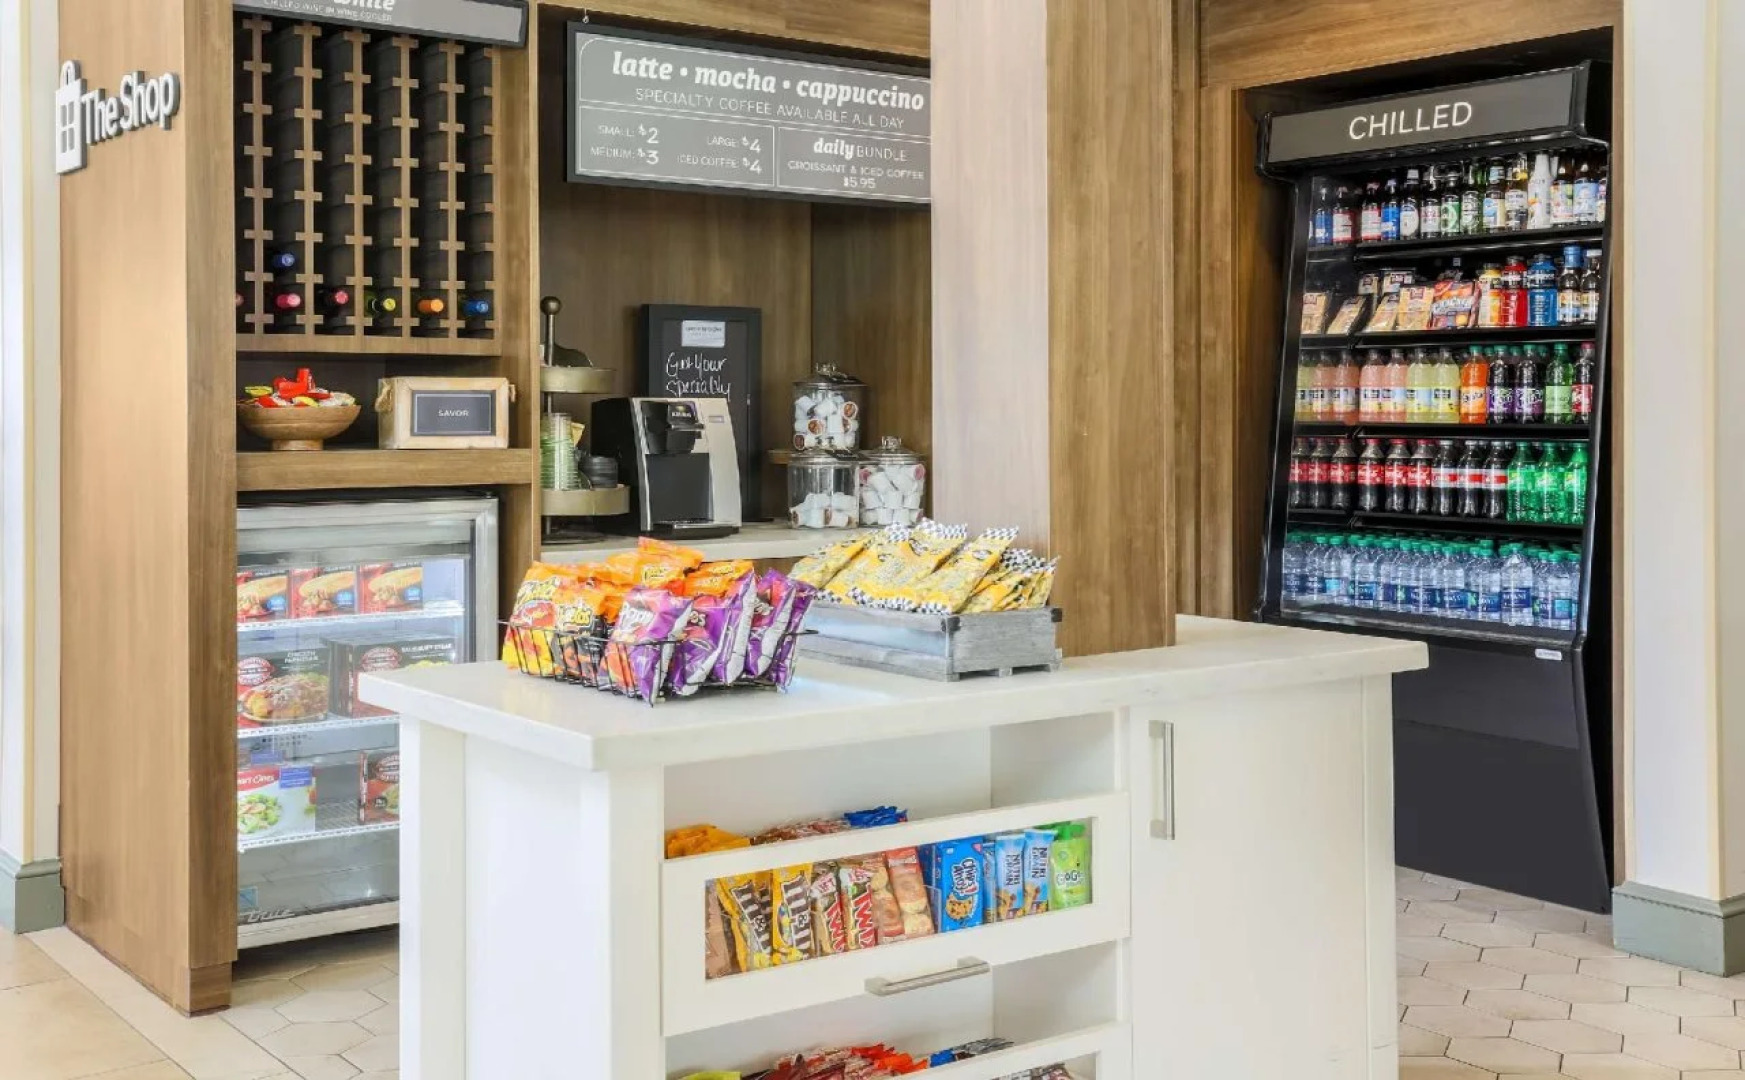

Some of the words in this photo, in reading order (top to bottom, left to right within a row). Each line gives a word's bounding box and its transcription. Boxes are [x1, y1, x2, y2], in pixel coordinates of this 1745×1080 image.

[612, 51, 673, 80] latte
[694, 66, 777, 93] mocha
[796, 79, 924, 110] cappuccino
[636, 88, 714, 108] SPECIALTY
[719, 97, 773, 115] COFFEE
[776, 104, 848, 124] AVAILABLE
[852, 113, 876, 127] ALL
[880, 115, 904, 129] DAY
[1349, 101, 1473, 141] CHILLED
[813, 138, 855, 160] daily
[856, 145, 908, 162] BUNDLE
[787, 160, 846, 174] CROISSANT
[860, 166, 884, 177] ICED
[887, 168, 925, 180] COFFEE
[438, 409, 469, 417] SAVOR
